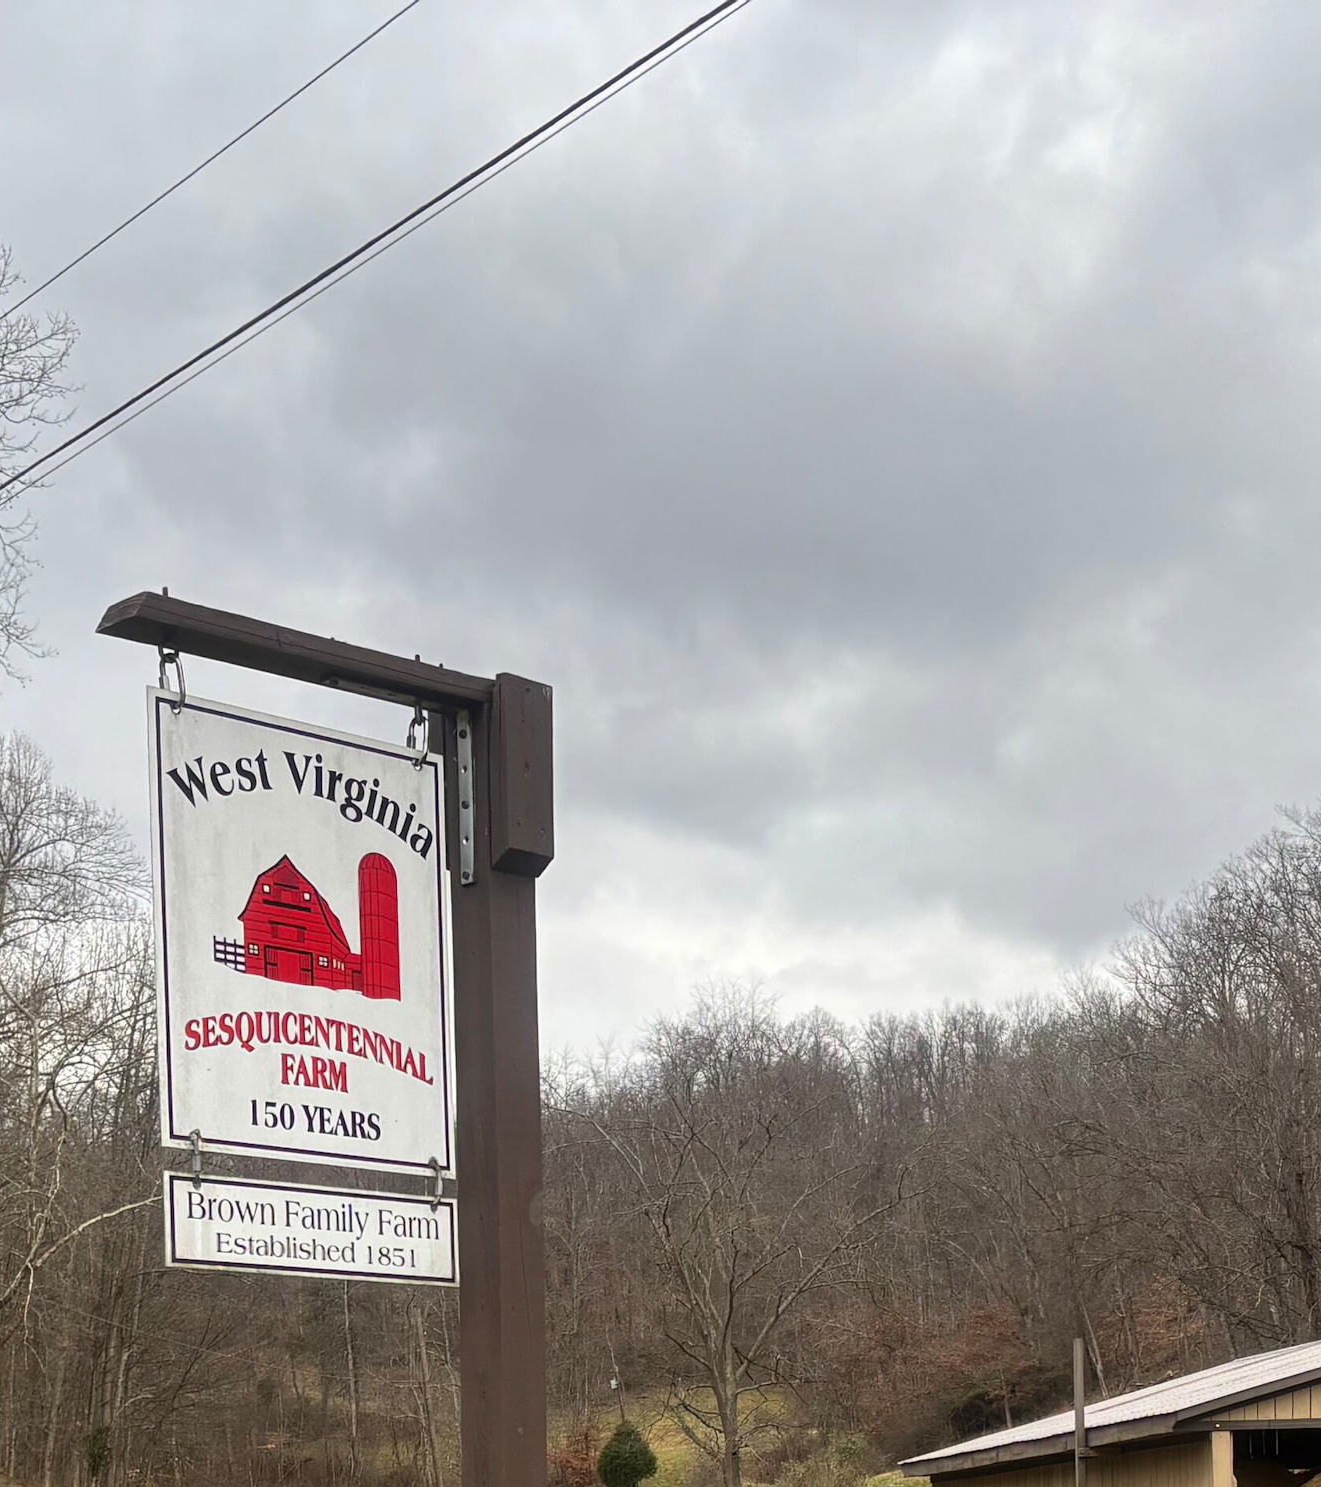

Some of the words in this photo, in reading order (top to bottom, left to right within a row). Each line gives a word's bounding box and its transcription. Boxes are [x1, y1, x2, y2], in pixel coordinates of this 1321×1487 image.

[166, 749, 273, 808] West
[282, 751, 433, 860] Virginia
[184, 1011, 433, 1085] SESQUICENTENNIAL
[281, 1053, 349, 1093] FARM
[251, 1100, 295, 1130] 150
[301, 1104, 381, 1141] YEARS
[187, 1191, 276, 1226] Brown
[285, 1201, 369, 1240] Family
[378, 1209, 439, 1240] Farm
[216, 1233, 356, 1263] Established
[367, 1246, 416, 1268] 1851
